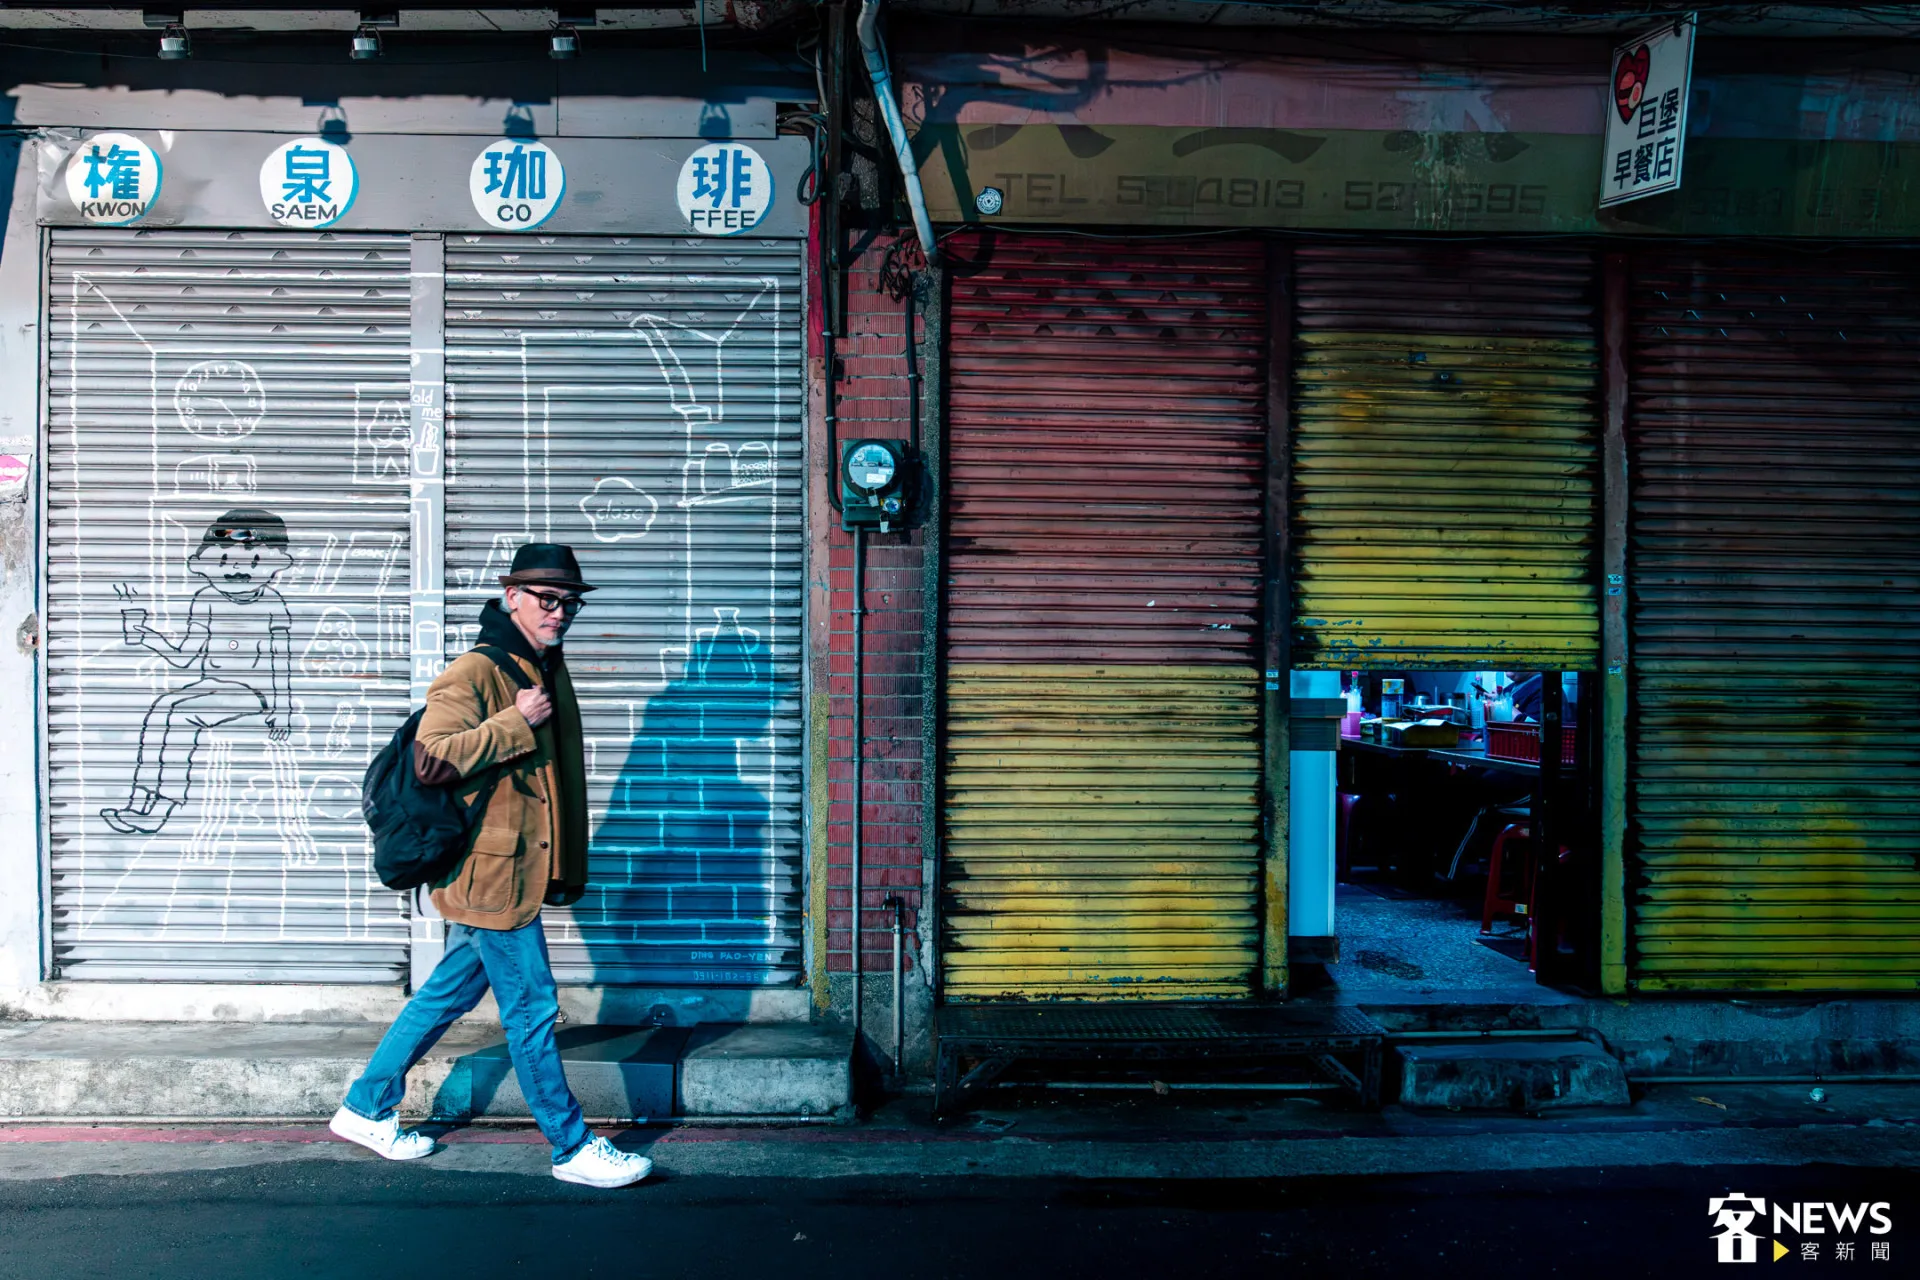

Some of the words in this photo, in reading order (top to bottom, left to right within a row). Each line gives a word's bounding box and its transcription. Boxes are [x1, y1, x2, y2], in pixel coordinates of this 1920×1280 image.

[1636, 87, 1680, 140] 巨堡
[282, 145, 332, 203] 泉
[484, 145, 547, 200] 珈
[692, 149, 752, 209] 琲
[1613, 137, 1676, 189] 早餐店
[80, 201, 146, 217] KWON
[271, 203, 338, 220] SAEM
[497, 204, 532, 222] CO
[690, 210, 756, 228] FFEE
[421, 407, 443, 418] me
